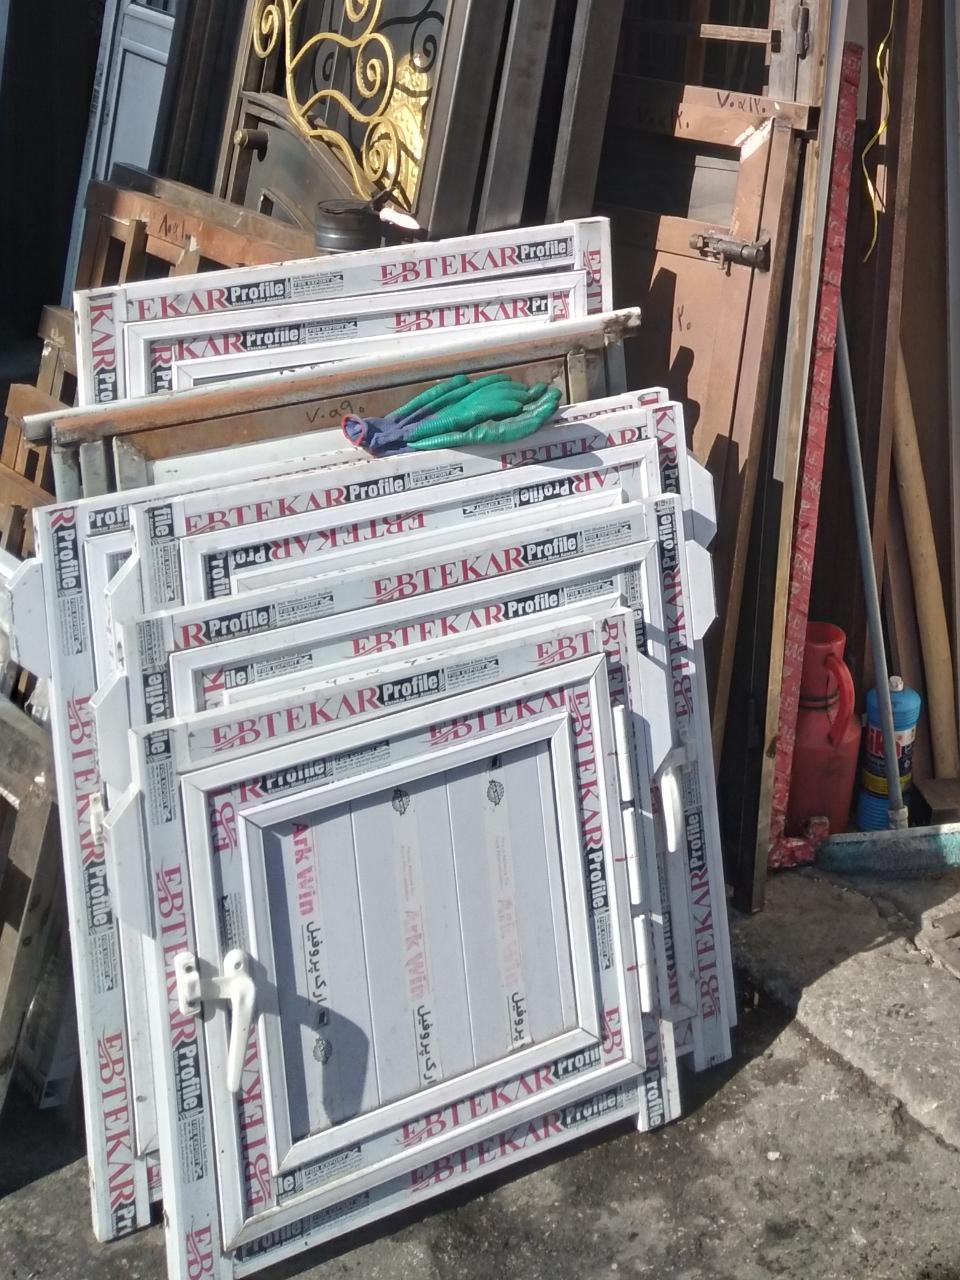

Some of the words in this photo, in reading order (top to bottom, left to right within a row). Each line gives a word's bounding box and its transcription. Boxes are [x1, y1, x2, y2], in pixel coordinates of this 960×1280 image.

[378, 245, 520, 286] EBTEKAR
[521, 238, 568, 261] Profile
[230, 281, 285, 303] Profile
[391, 297, 530, 333] EBTEKAR
[246, 326, 299, 350] Profile
[185, 487, 347, 536] EBTEKAR
[350, 474, 403, 501] Profile
[520, 480, 570, 505] Profile
[57, 531, 77, 590] Profile
[660, 512, 677, 567] Profile
[366, 546, 525, 604] EBTEKAR
[526, 535, 577, 561] Profile
[209, 609, 269, 636] Profile
[351, 603, 504, 658] EBTEKAR
[507, 592, 559, 618] Profile
[531, 629, 595, 666] EBT
[663, 564, 694, 721] EBTEKAR
[204, 687, 382, 752] EBTEKAR
[382, 674, 438, 702] Profile
[568, 686, 604, 849] EBTEKAR
[588, 852, 607, 909] Profile
[291, 822, 313, 865] Ark
[687, 811, 705, 869] Profile
[87, 867, 110, 929] Profile
[296, 867, 315, 917] Win
[306, 920, 322, 974] پروفیل
[688, 866, 721, 1021] EBTEKAR
[416, 1005, 433, 1056] پروفیل
[180, 1044, 201, 1111] Profile
[400, 1064, 556, 1147] EBTEKAR
[646, 1068, 664, 1128] Profile
[96, 1027, 137, 1208] EBTEKAR
[410, 1109, 563, 1192] EBTEKAR
[565, 1095, 617, 1127] Profile
